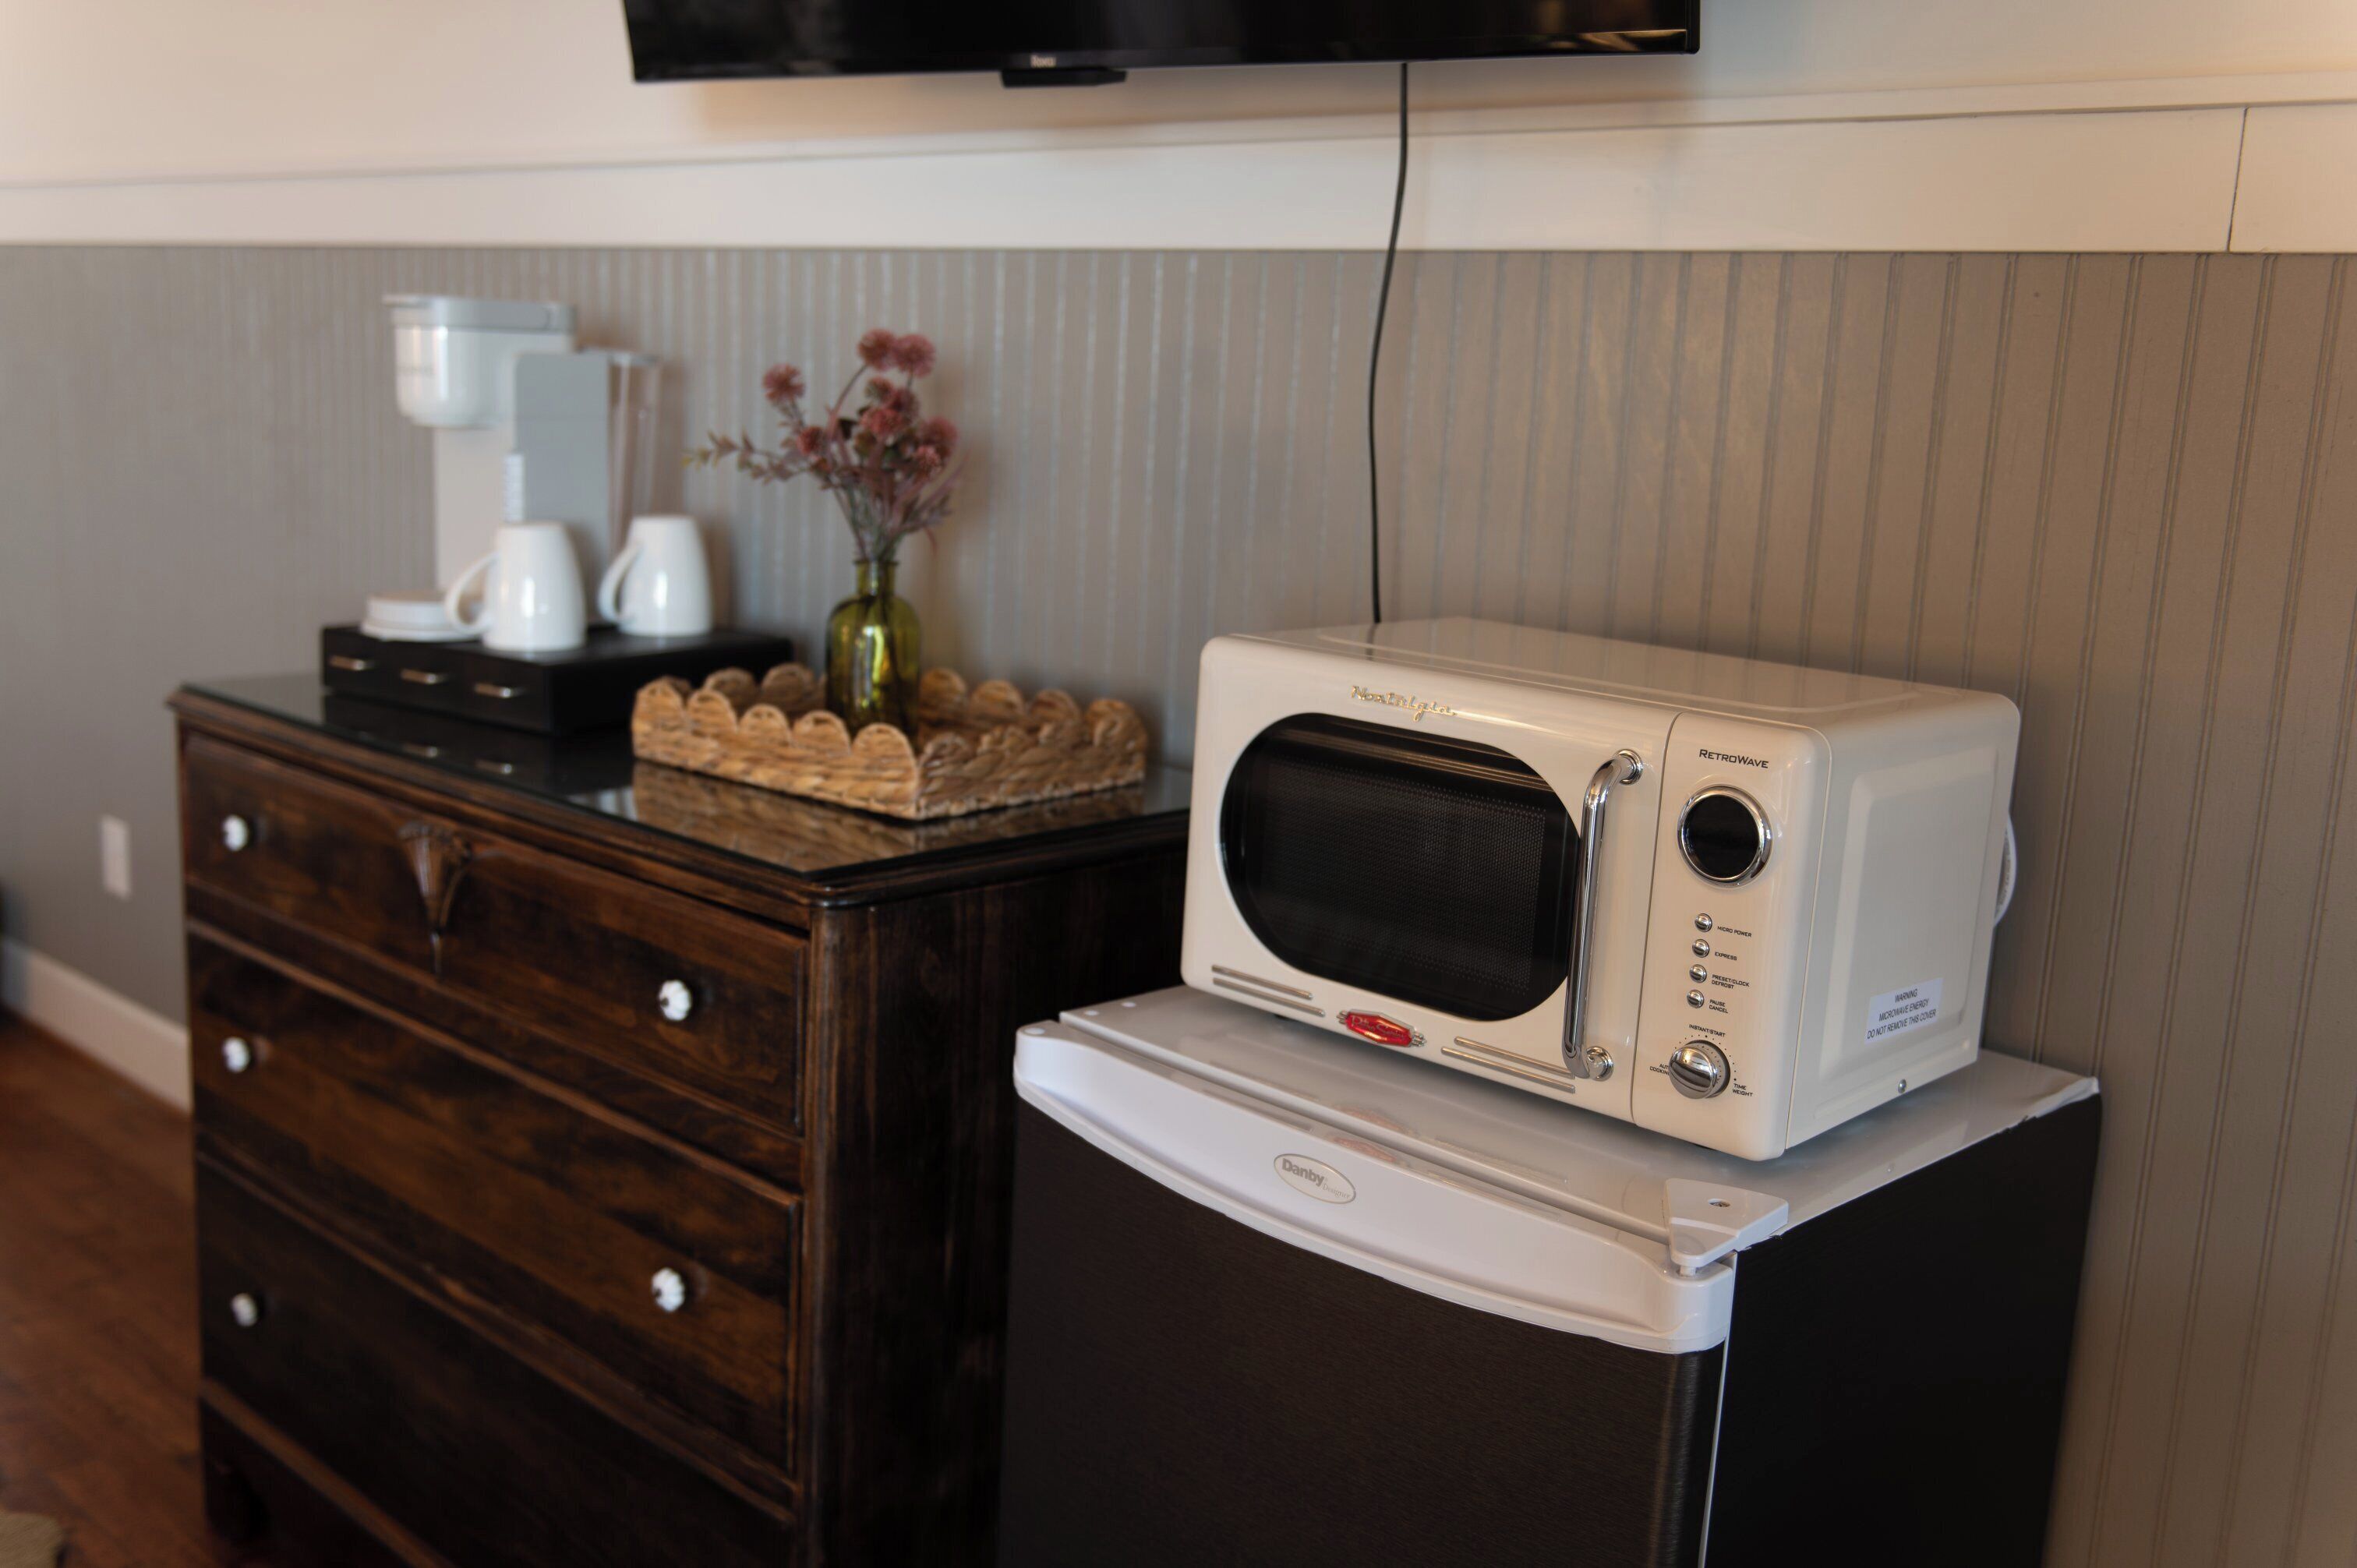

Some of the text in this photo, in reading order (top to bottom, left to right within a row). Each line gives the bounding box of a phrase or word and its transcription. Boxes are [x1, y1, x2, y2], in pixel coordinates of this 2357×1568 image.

[1715, 952, 1737, 960] EXPRESS
[1712, 974, 1750, 987] PRESET/CLOCK
[1712, 980, 1734, 989] DEFROST
[1895, 988, 1918, 1003] WARNING
[1709, 1005, 1729, 1014] CANCEL
[1878, 998, 1929, 1021] MICROWAVE ENERGY
[1688, 1024, 1726, 1037] INSTANT/START
[1867, 1008, 1937, 1040] DO NOT REMOVE THIS COVER
[1649, 1065, 1670, 1075] COOKIN
[1282, 1158, 1324, 1187] Danby
